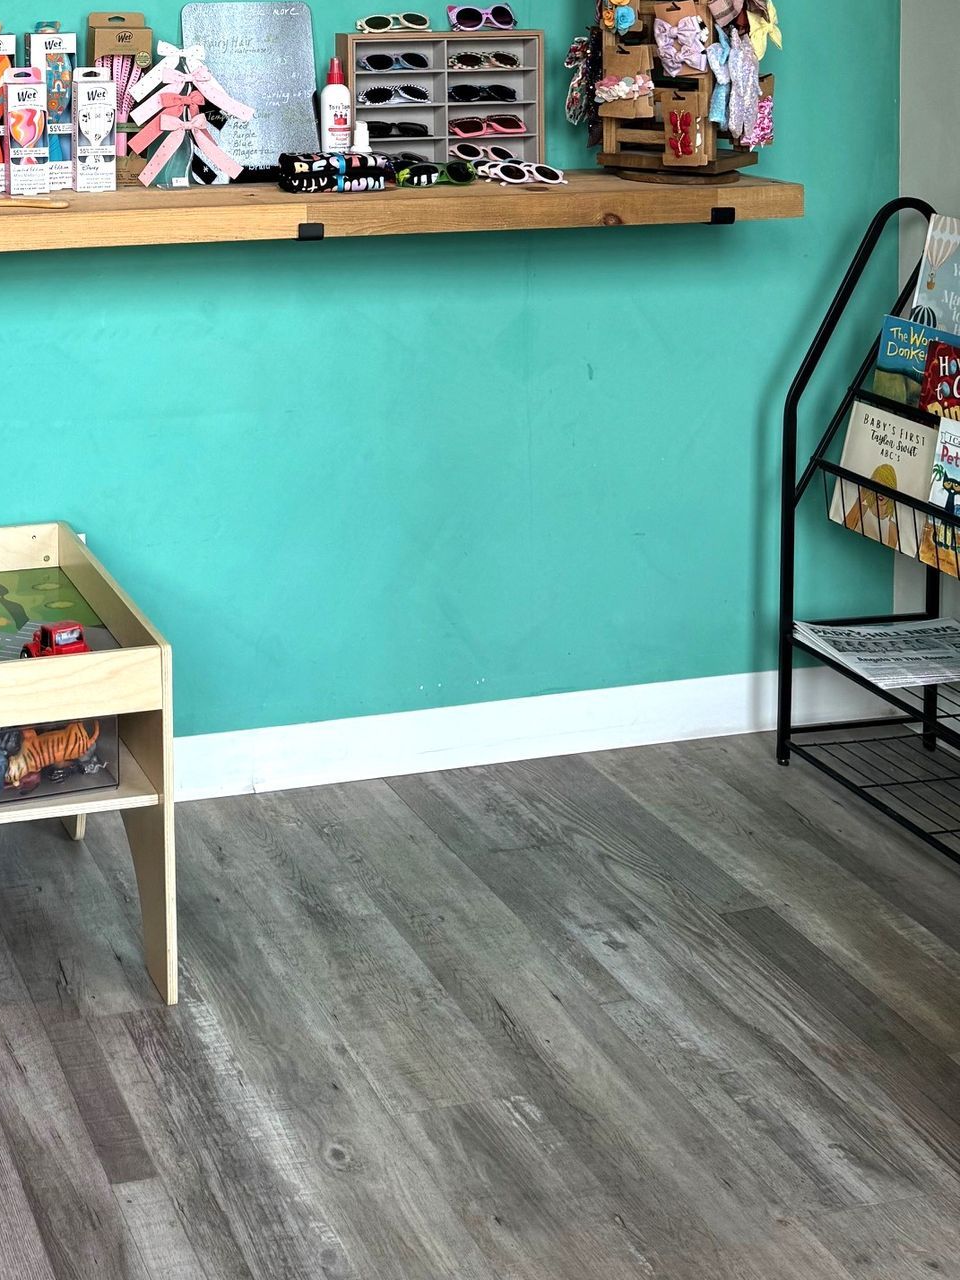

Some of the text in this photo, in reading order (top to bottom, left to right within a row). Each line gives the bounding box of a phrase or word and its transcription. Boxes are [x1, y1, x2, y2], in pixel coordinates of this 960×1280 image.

[44, 39, 62, 50] Wet
[118, 32, 133, 43] Wet
[17, 90, 37, 102] Wet
[87, 89, 107, 101] Wet
[890, 327, 908, 343] The
[886, 340, 926, 364] Donke
[863, 413, 926, 446] BABY'S FIRST
[870, 428, 919, 458] Taylor Swift
[879, 448, 902, 463] ABC'S
[941, 445, 960, 468] Pet
[906, 625, 960, 636] NEWS
